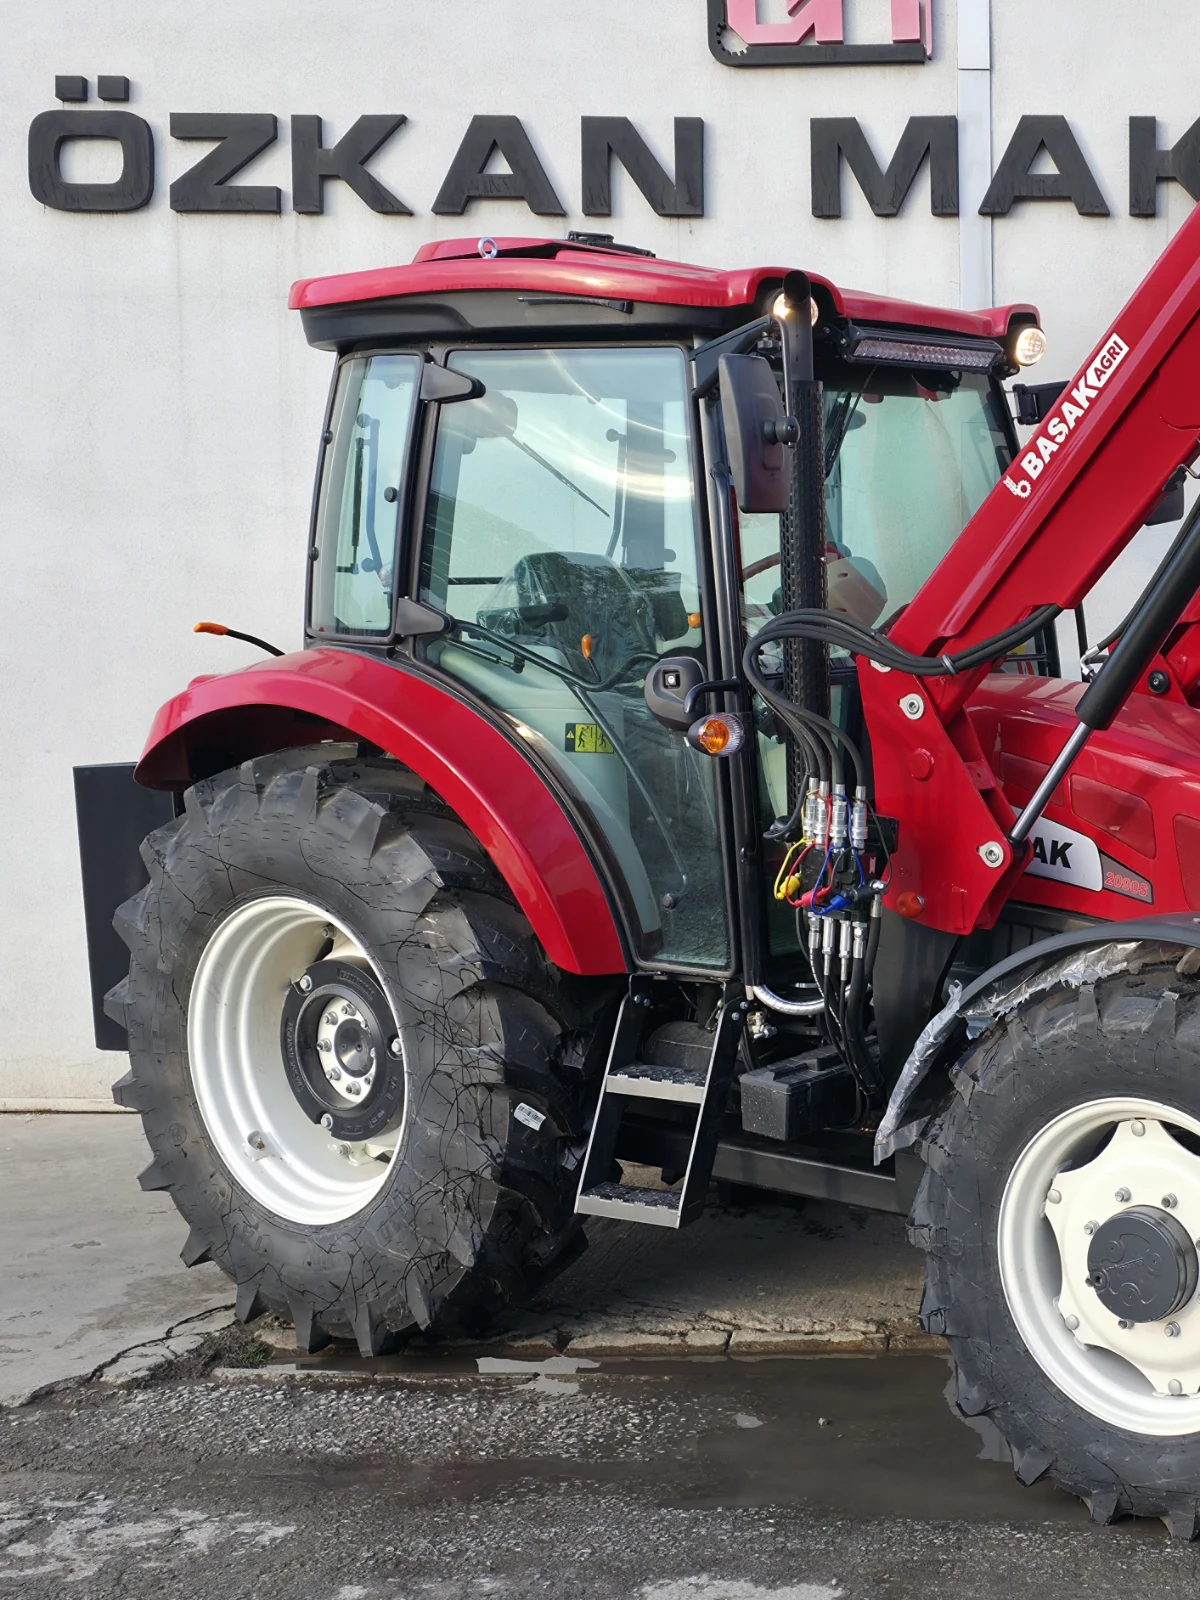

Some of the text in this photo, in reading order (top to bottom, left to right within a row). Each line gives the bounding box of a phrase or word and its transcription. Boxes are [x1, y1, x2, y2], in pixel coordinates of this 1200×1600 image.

[28, 75, 705, 217] ÖZKAN
[1020, 340, 1124, 480] BASAK AGRI
[1105, 871, 1148, 897] 2090S
